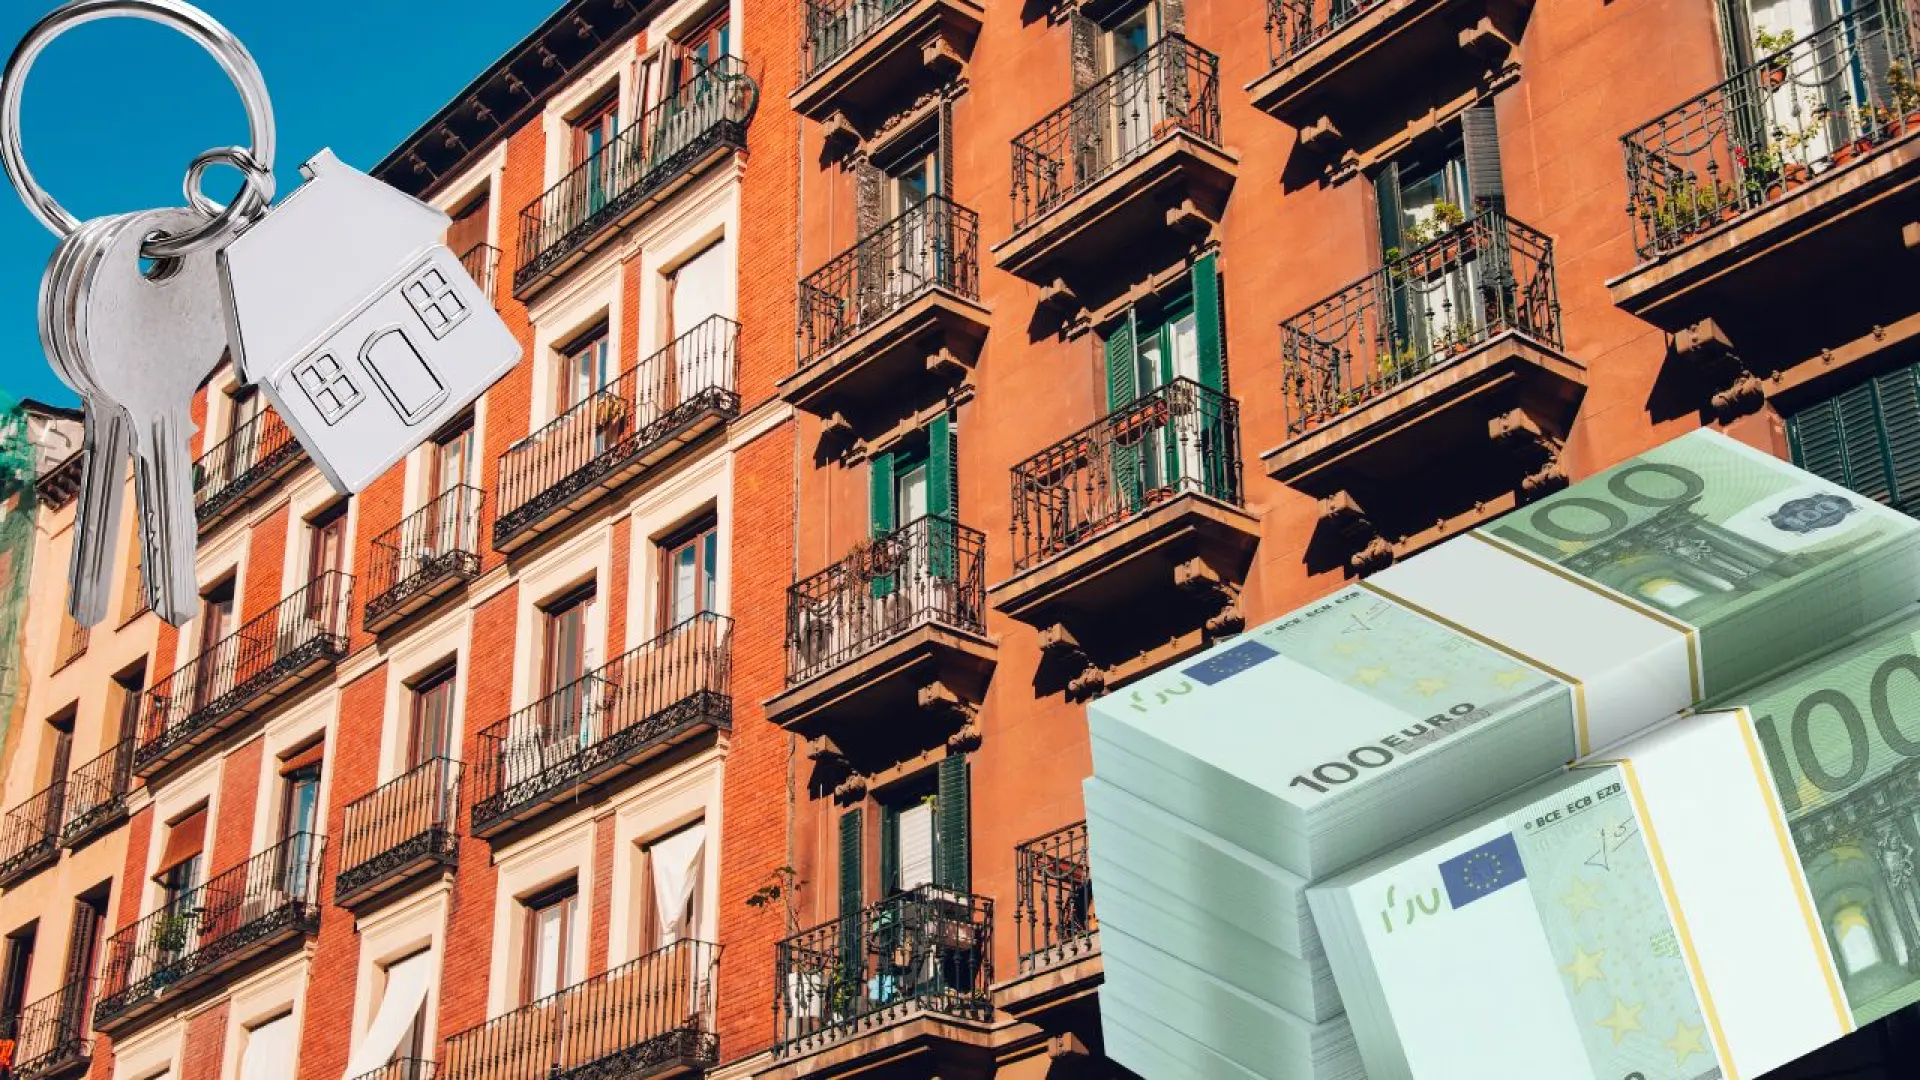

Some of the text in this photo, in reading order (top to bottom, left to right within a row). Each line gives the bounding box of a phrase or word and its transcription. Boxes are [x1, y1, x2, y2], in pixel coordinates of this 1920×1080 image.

[1490, 463, 1704, 562] 100
[1783, 501, 1843, 529] 100
[1755, 654, 1920, 814] 100
[1536, 809, 1562, 828] BCE
[1566, 796, 1593, 814] ECB
[1596, 782, 1621, 800] EZB
